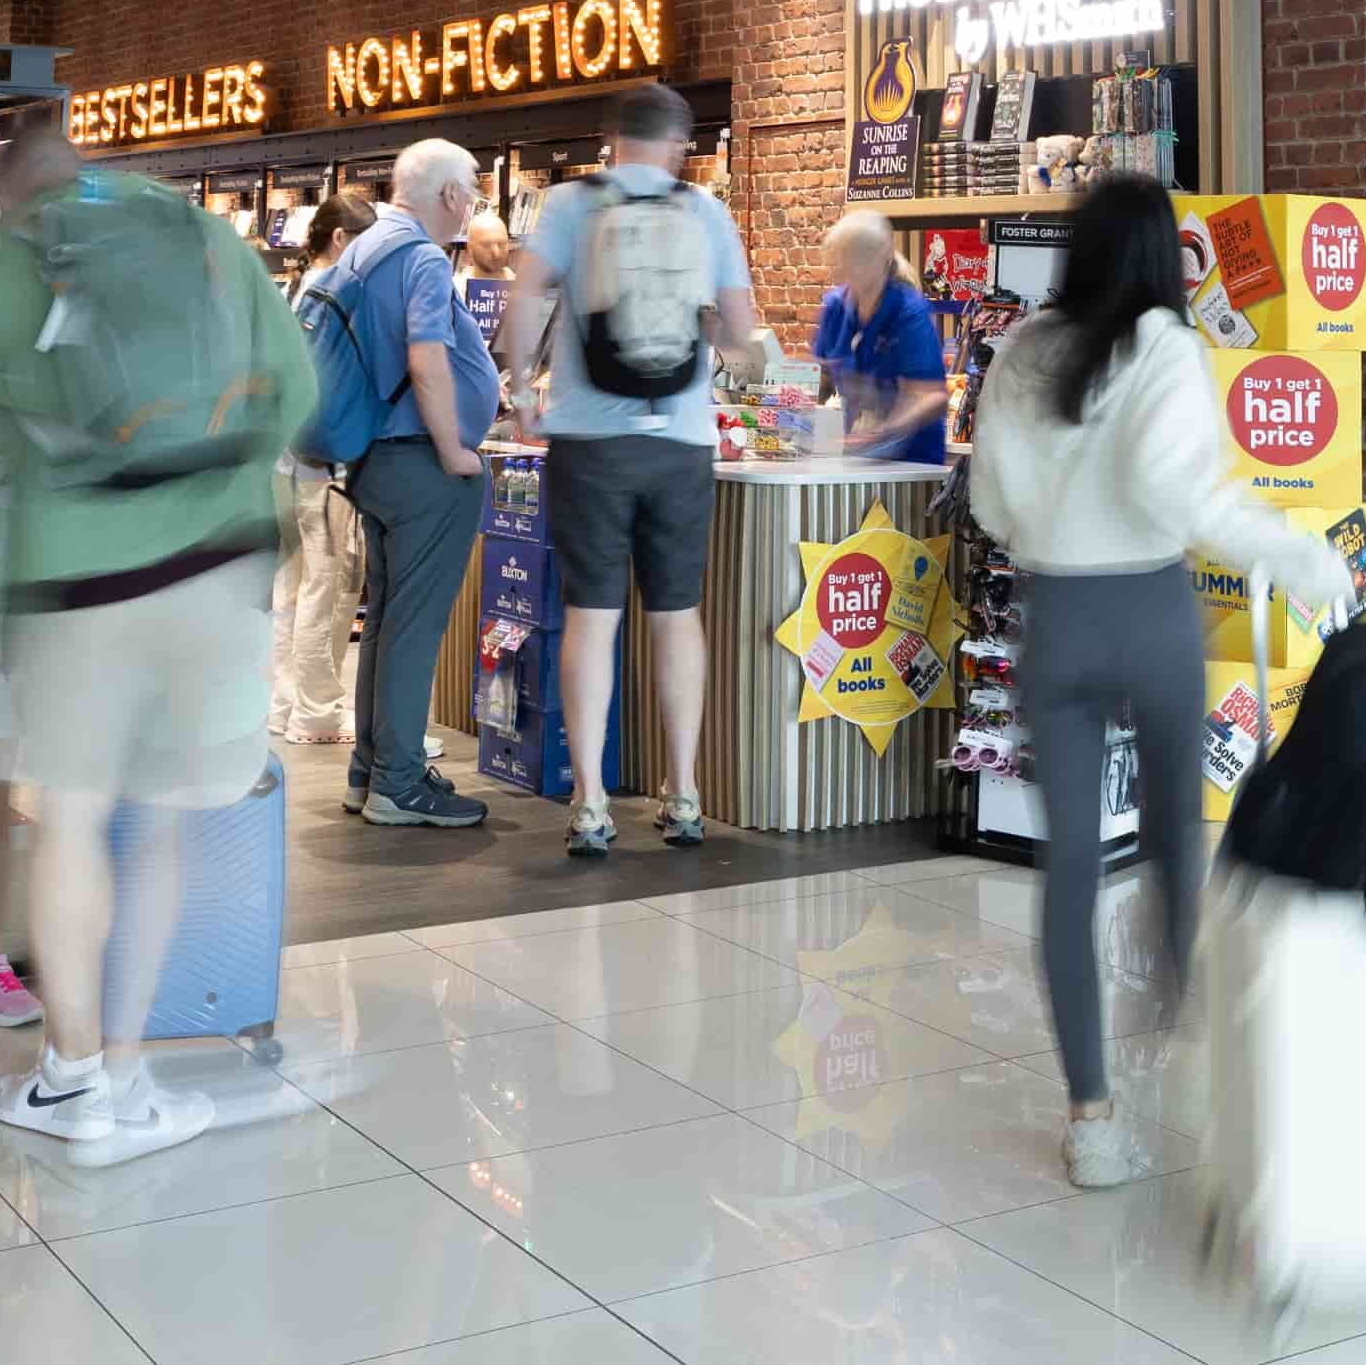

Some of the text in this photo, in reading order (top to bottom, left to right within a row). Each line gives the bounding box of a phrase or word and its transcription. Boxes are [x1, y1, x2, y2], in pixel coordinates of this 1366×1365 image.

[954, 7, 989, 64] by
[67, 61, 267, 146] BESTSELLERS
[862, 124, 908, 144] SUNRISE
[870, 144, 897, 155] ON THE
[858, 155, 908, 175] REAPING
[1001, 227, 1037, 238] FOSTER
[1312, 224, 1358, 239] Buy 1 get 1
[1312, 236, 1358, 270] half
[1316, 271, 1354, 294] price
[469, 299, 495, 313] Half
[1317, 322, 1354, 333] All books
[1243, 377, 1321, 392] Buy 1 get 1
[1243, 390, 1322, 424] half
[1250, 425, 1315, 450] price
[1252, 477, 1315, 489] All books
[828, 571, 882, 585] Buy 1 get 1
[1187, 570, 1275, 602] UMM
[828, 583, 883, 613] half
[833, 614, 877, 635] price
[850, 656, 873, 673] All
[837, 677, 885, 694] books
[1270, 696, 1301, 711] MORT
[1215, 741, 1244, 771] Solve
